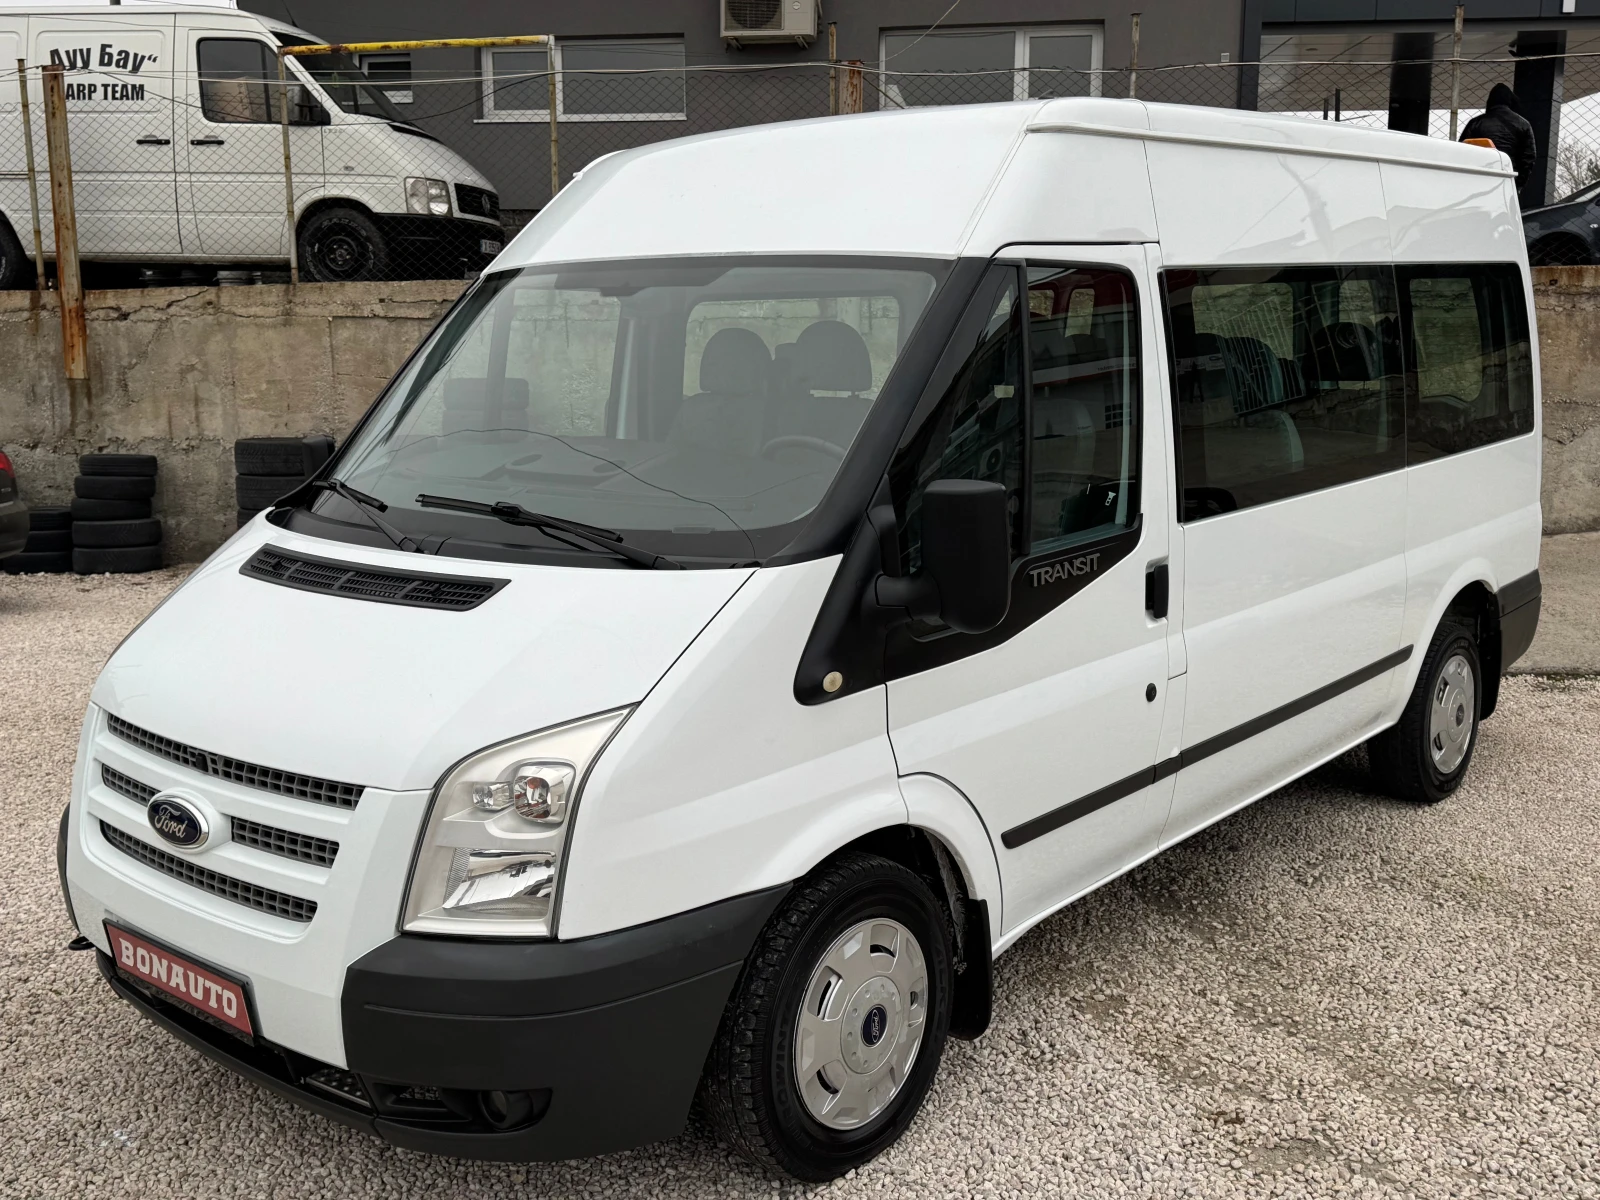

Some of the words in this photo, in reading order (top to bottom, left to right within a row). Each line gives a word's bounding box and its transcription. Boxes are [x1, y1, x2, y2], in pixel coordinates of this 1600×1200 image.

[101, 83, 145, 101] TEAM
[1028, 552, 1101, 587] TRANSIT
[154, 804, 188, 838] Ford
[119, 937, 237, 1019] BONAUTO
